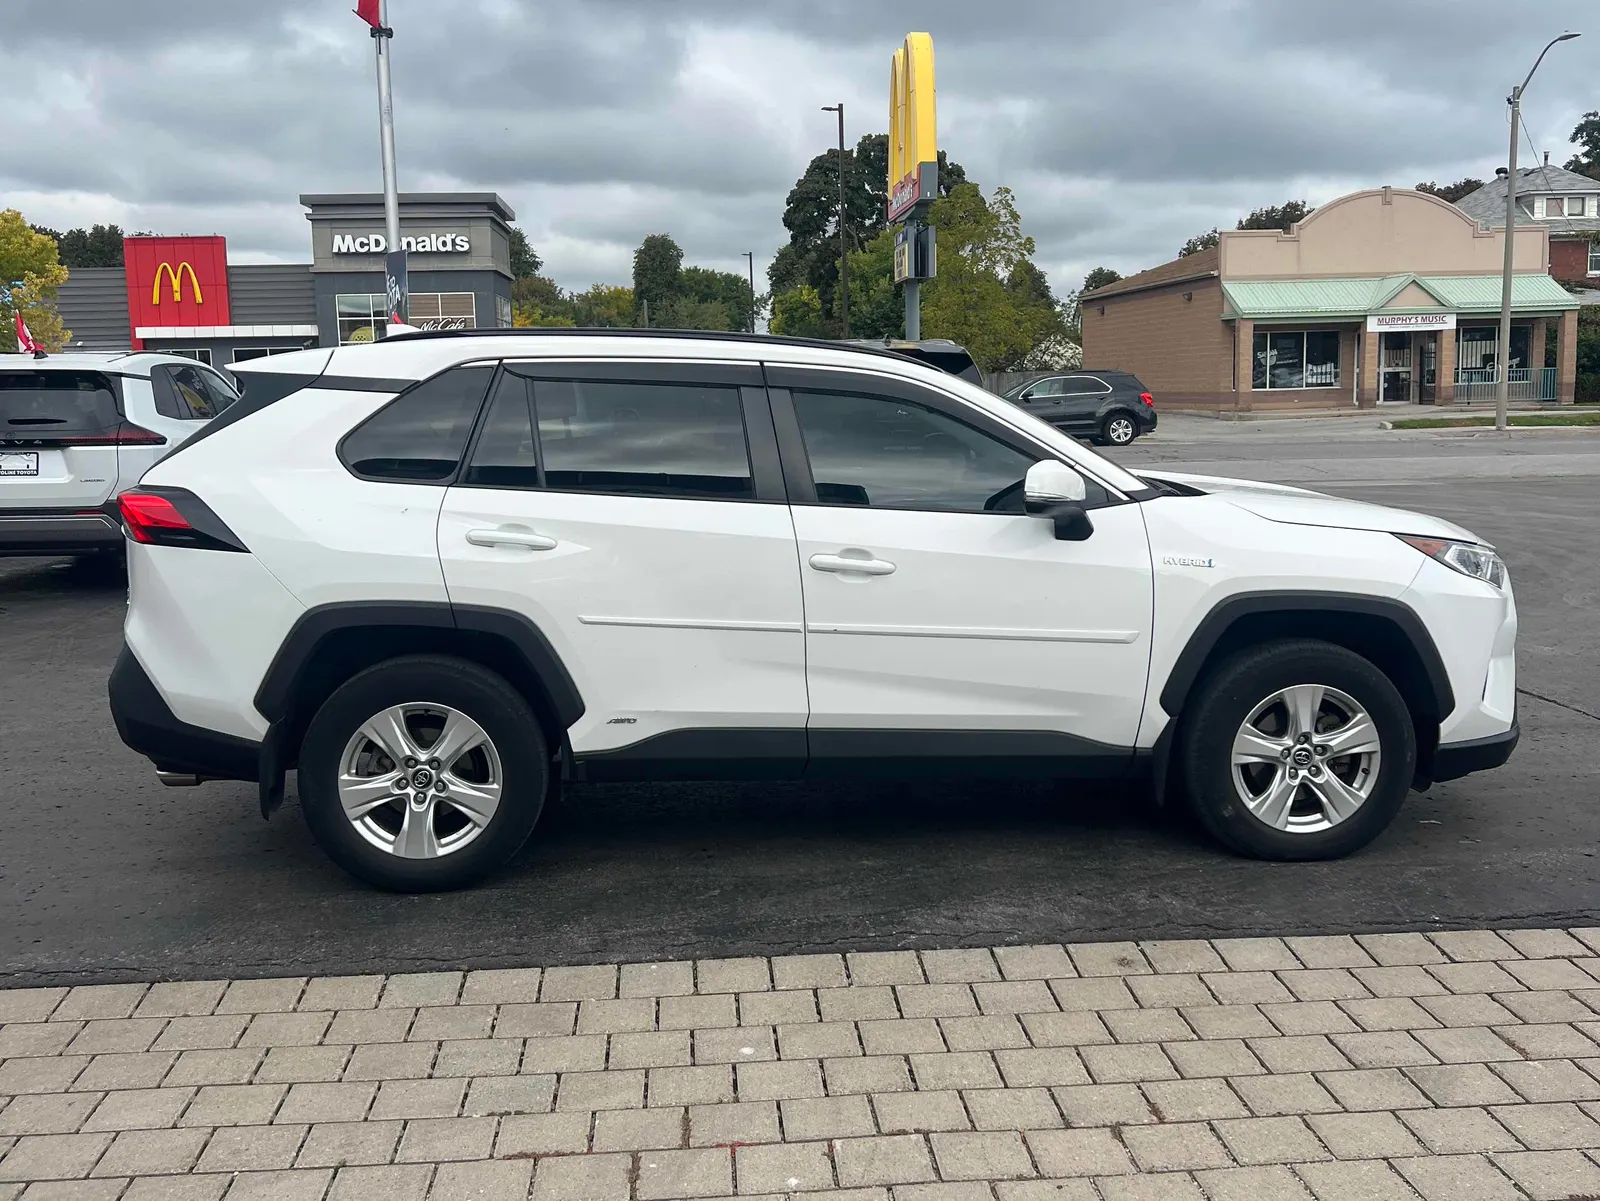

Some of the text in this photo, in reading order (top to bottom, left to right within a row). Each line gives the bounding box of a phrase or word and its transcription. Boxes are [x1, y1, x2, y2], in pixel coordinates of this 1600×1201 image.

[332, 233, 470, 252] McDnald's
[1377, 315, 1447, 325] MURPHY'S MUSIC
[1163, 556, 1208, 568] HYBRID
